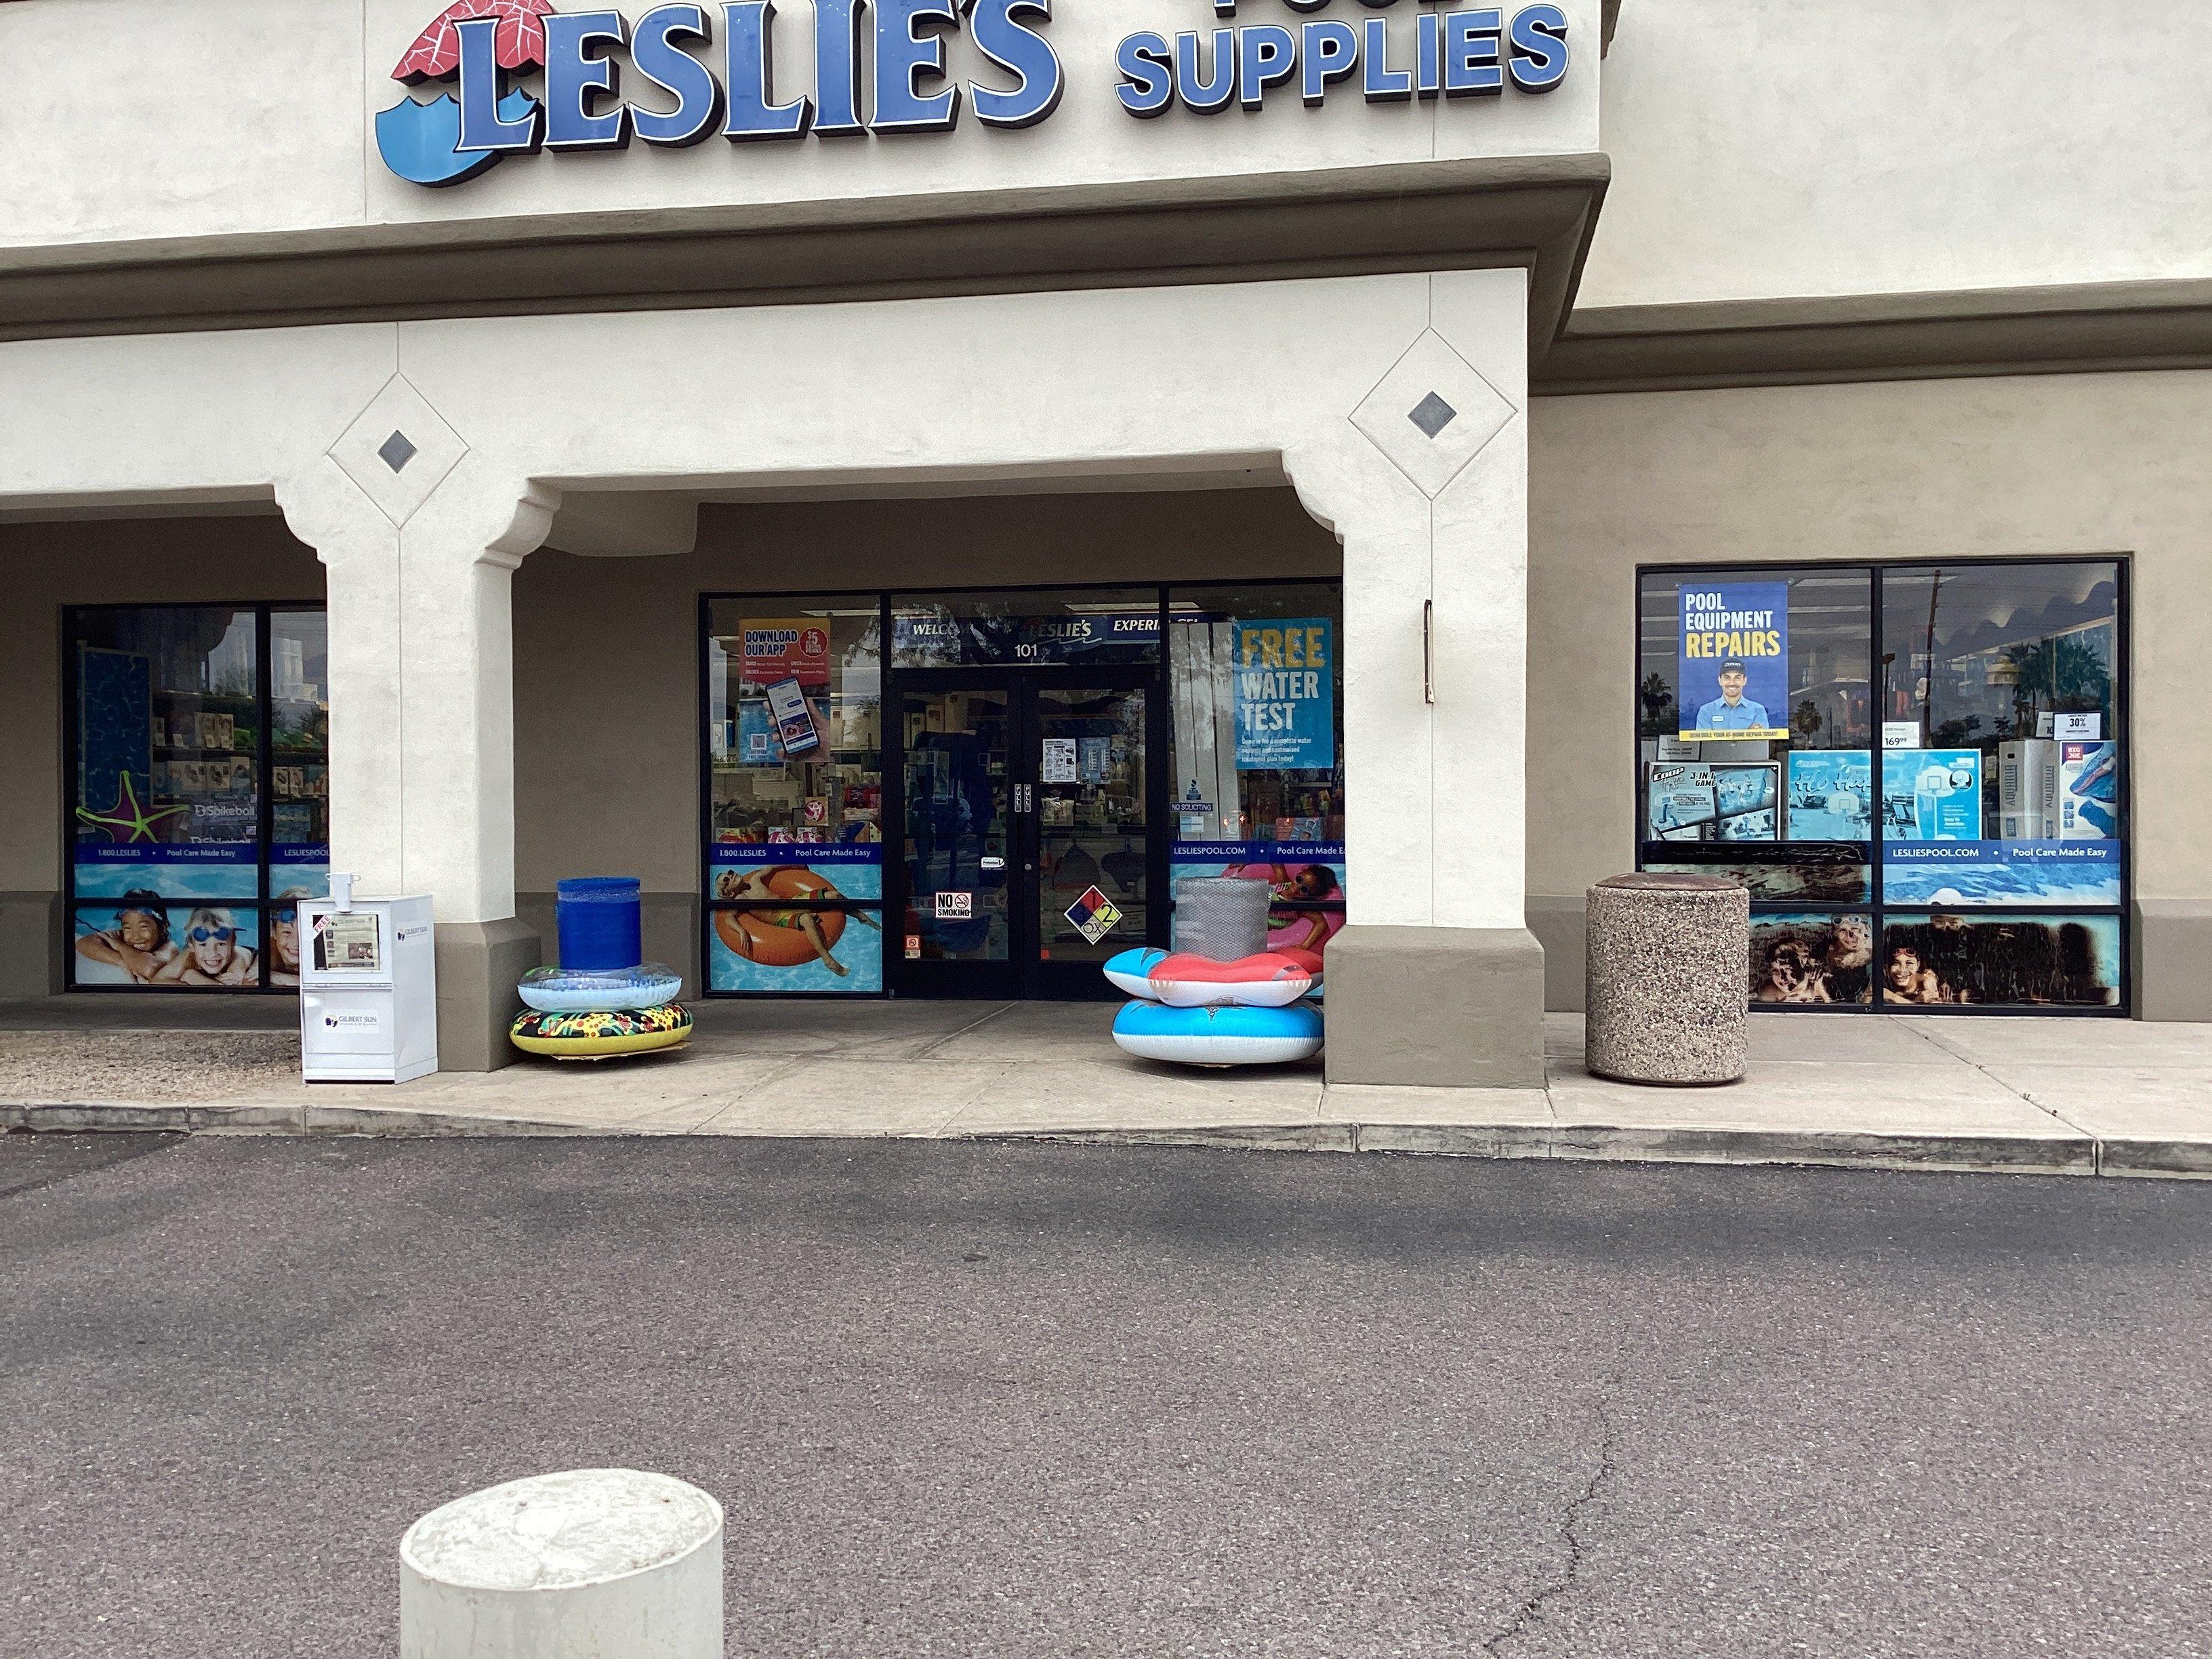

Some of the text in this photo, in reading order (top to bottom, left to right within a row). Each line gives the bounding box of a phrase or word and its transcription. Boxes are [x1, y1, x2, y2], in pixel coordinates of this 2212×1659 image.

[1114, 3, 1570, 118] SUPPLIES
[455, 0, 1065, 152] LESLIES
[1685, 592, 1726, 611] POOL
[1113, 619, 1161, 632] EXPERI
[1685, 611, 1774, 631] EQUIPMENT
[745, 630, 798, 643] DOWNLOAD
[745, 644, 786, 656] OUR APP
[1014, 644, 1038, 657] 101
[1241, 628, 1325, 669] FREE
[1685, 630, 1781, 659] REPAIRS
[1241, 671, 1319, 701] WATER
[1240, 703, 1296, 731] TEST
[2069, 718, 2086, 727] 30%
[1654, 767, 1685, 781] COOP
[1689, 771, 1716, 780] 3-IN-1
[205, 804, 255, 818] Spikeball
[220, 849, 236, 858] Easy
[795, 848, 871, 858] Pool Care Made Easy
[1174, 846, 1246, 855] LESLIESPOOL.COM
[1277, 846, 1295, 855] Pool
[1296, 846, 1314, 855] Care
[1315, 846, 1337, 855] Made
[1893, 848, 1980, 857] LESLIESPOOL.COM
[2012, 848, 2107, 858] Pool Care Made Easy
[938, 894, 953, 907] NO
[937, 909, 970, 917] SMOKING
[1101, 903, 1113, 922] 2
[314, 915, 331, 933] FREE
[1083, 922, 1102, 934] OX
